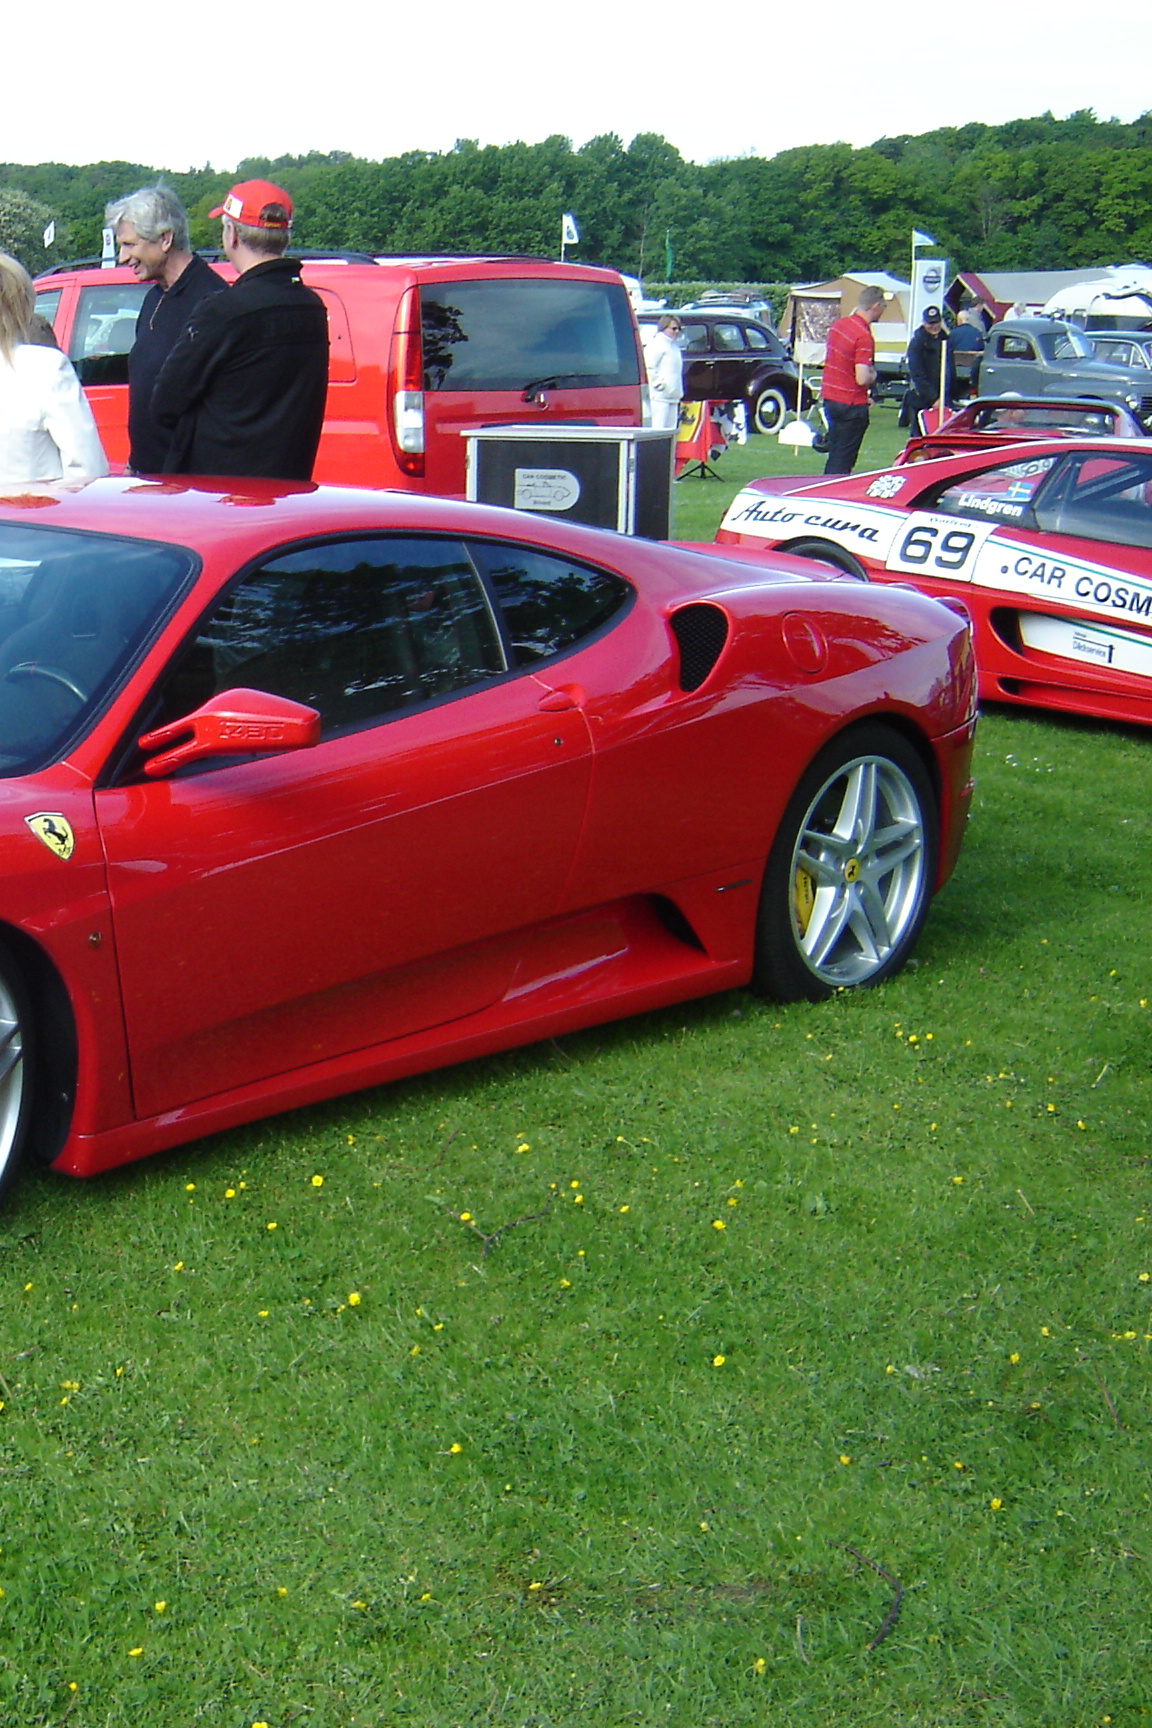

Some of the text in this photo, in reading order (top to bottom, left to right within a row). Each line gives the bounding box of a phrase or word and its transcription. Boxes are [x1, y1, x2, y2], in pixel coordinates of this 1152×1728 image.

[731, 501, 803, 523] Auto
[958, 493, 1023, 517] Lindgren
[899, 526, 976, 570] 69
